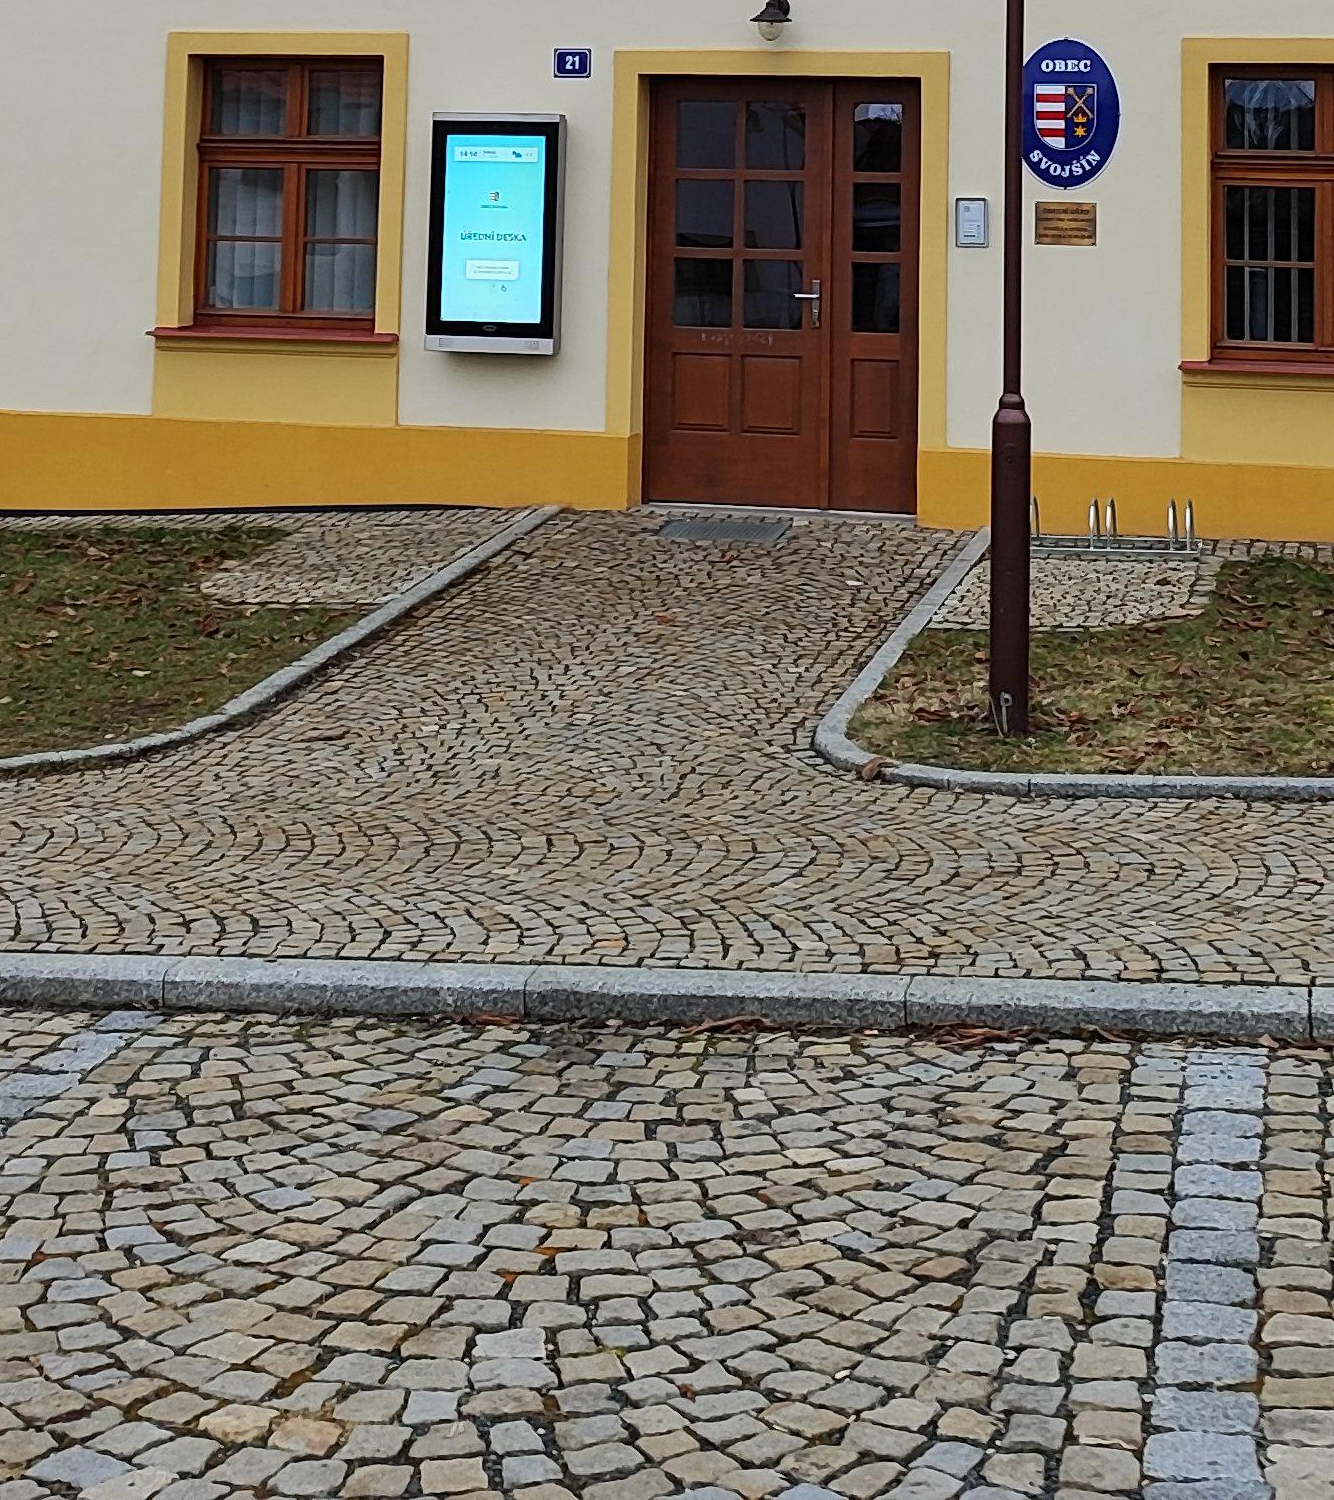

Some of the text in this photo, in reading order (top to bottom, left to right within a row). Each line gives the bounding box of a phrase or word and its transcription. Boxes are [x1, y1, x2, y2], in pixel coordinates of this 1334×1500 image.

[565, 55, 580, 70] 21
[1040, 59, 1092, 73] OBEC
[1029, 149, 1101, 177] SVOJŠÍN
[496, 232, 527, 242] DESKA
